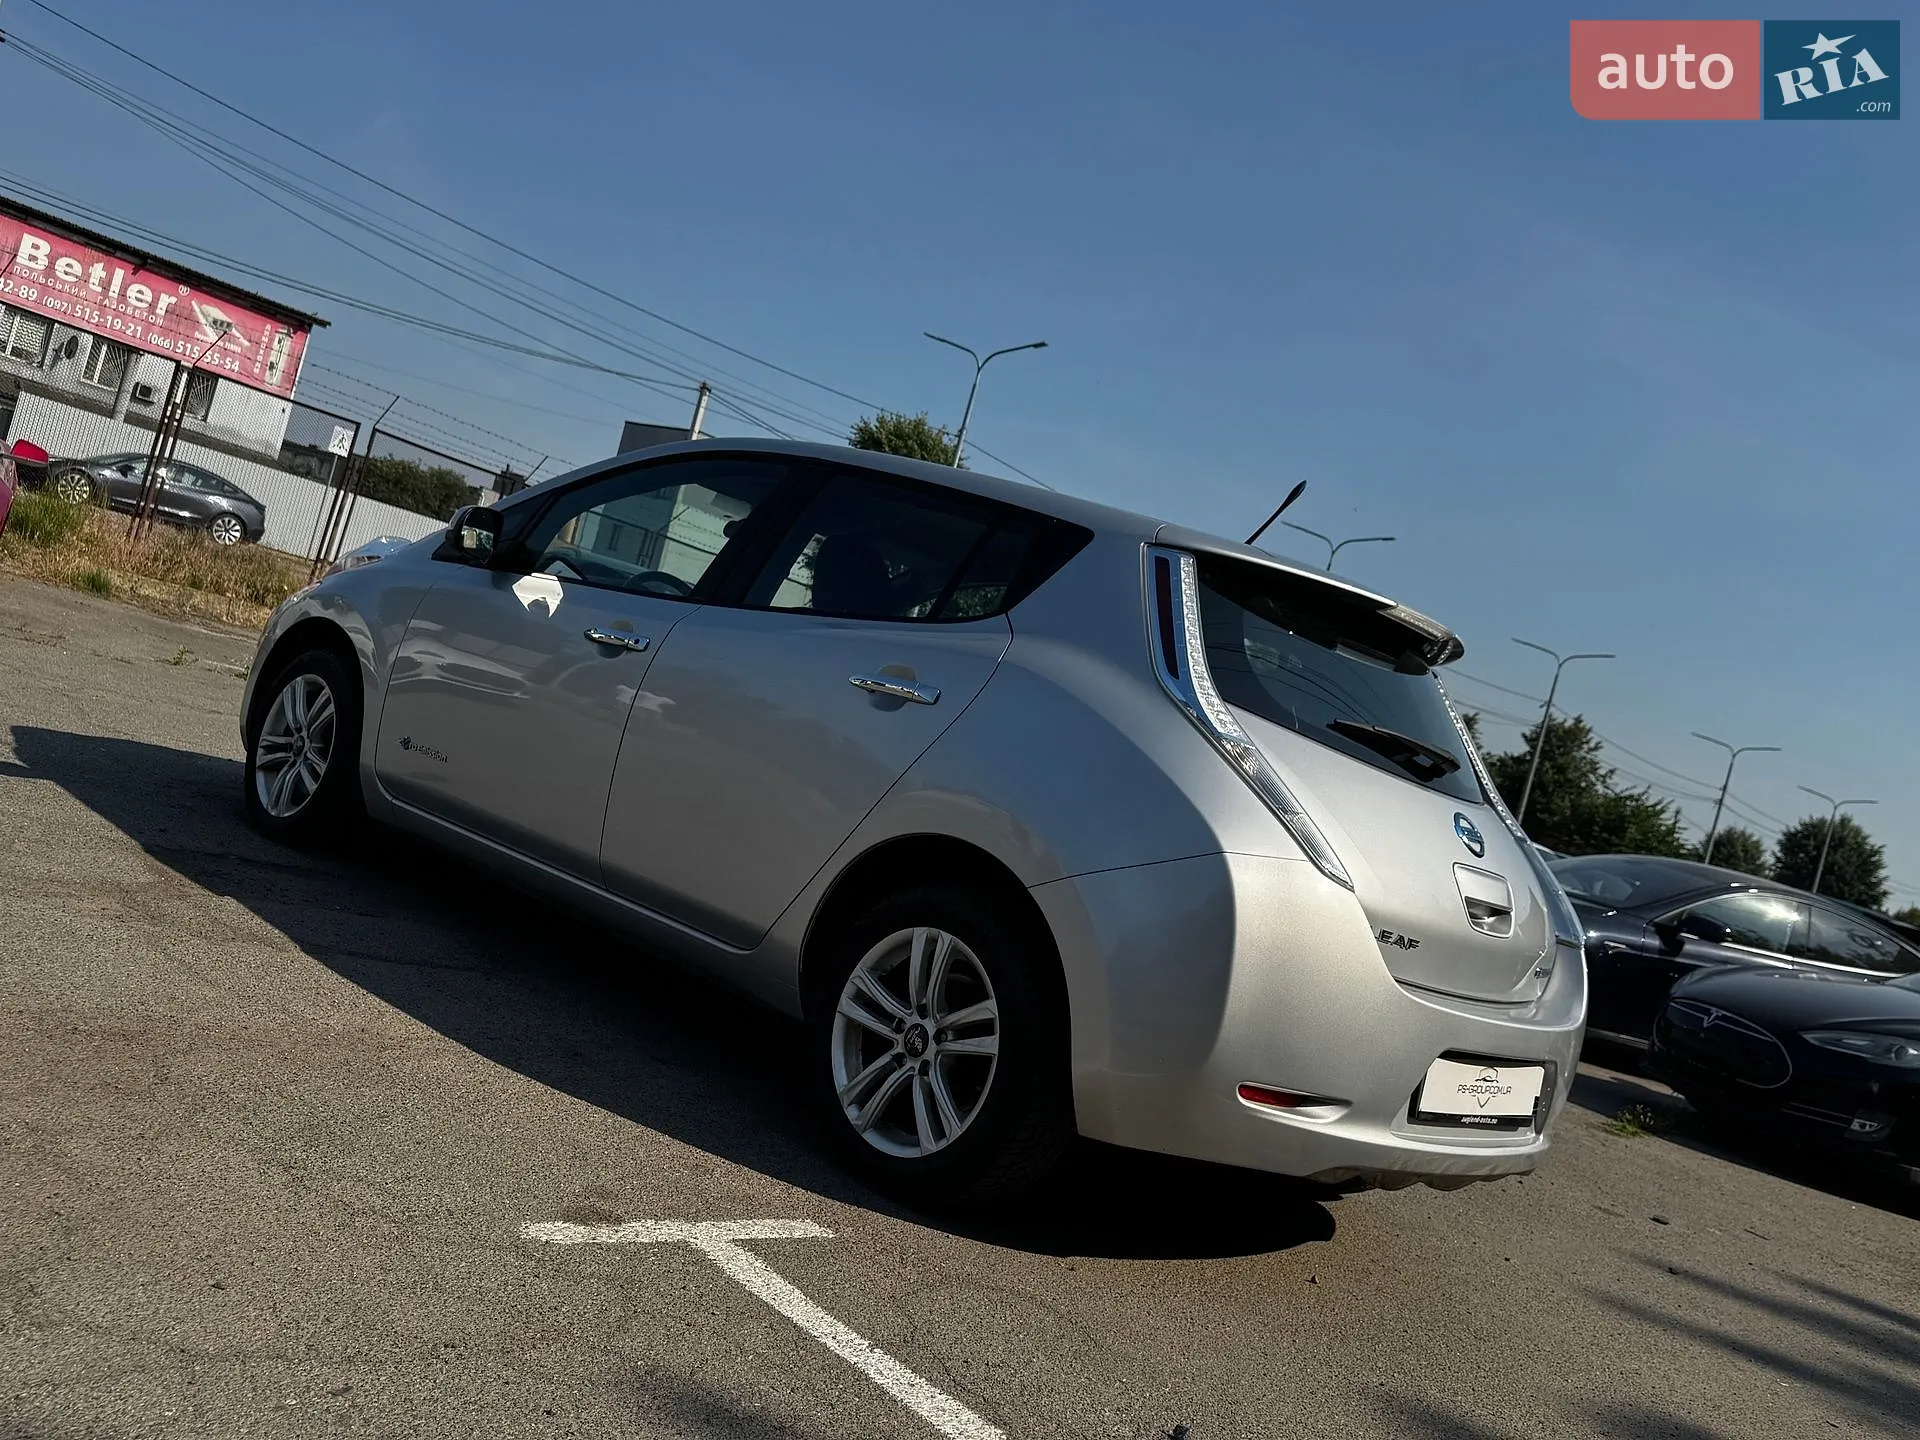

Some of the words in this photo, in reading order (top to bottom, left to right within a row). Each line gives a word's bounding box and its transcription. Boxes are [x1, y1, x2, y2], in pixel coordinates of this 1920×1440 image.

[15, 232, 178, 316] Betler
[42, 295, 72, 315] (097)
[148, 332, 174, 351] (066)
[1375, 928, 1420, 950] EAF
